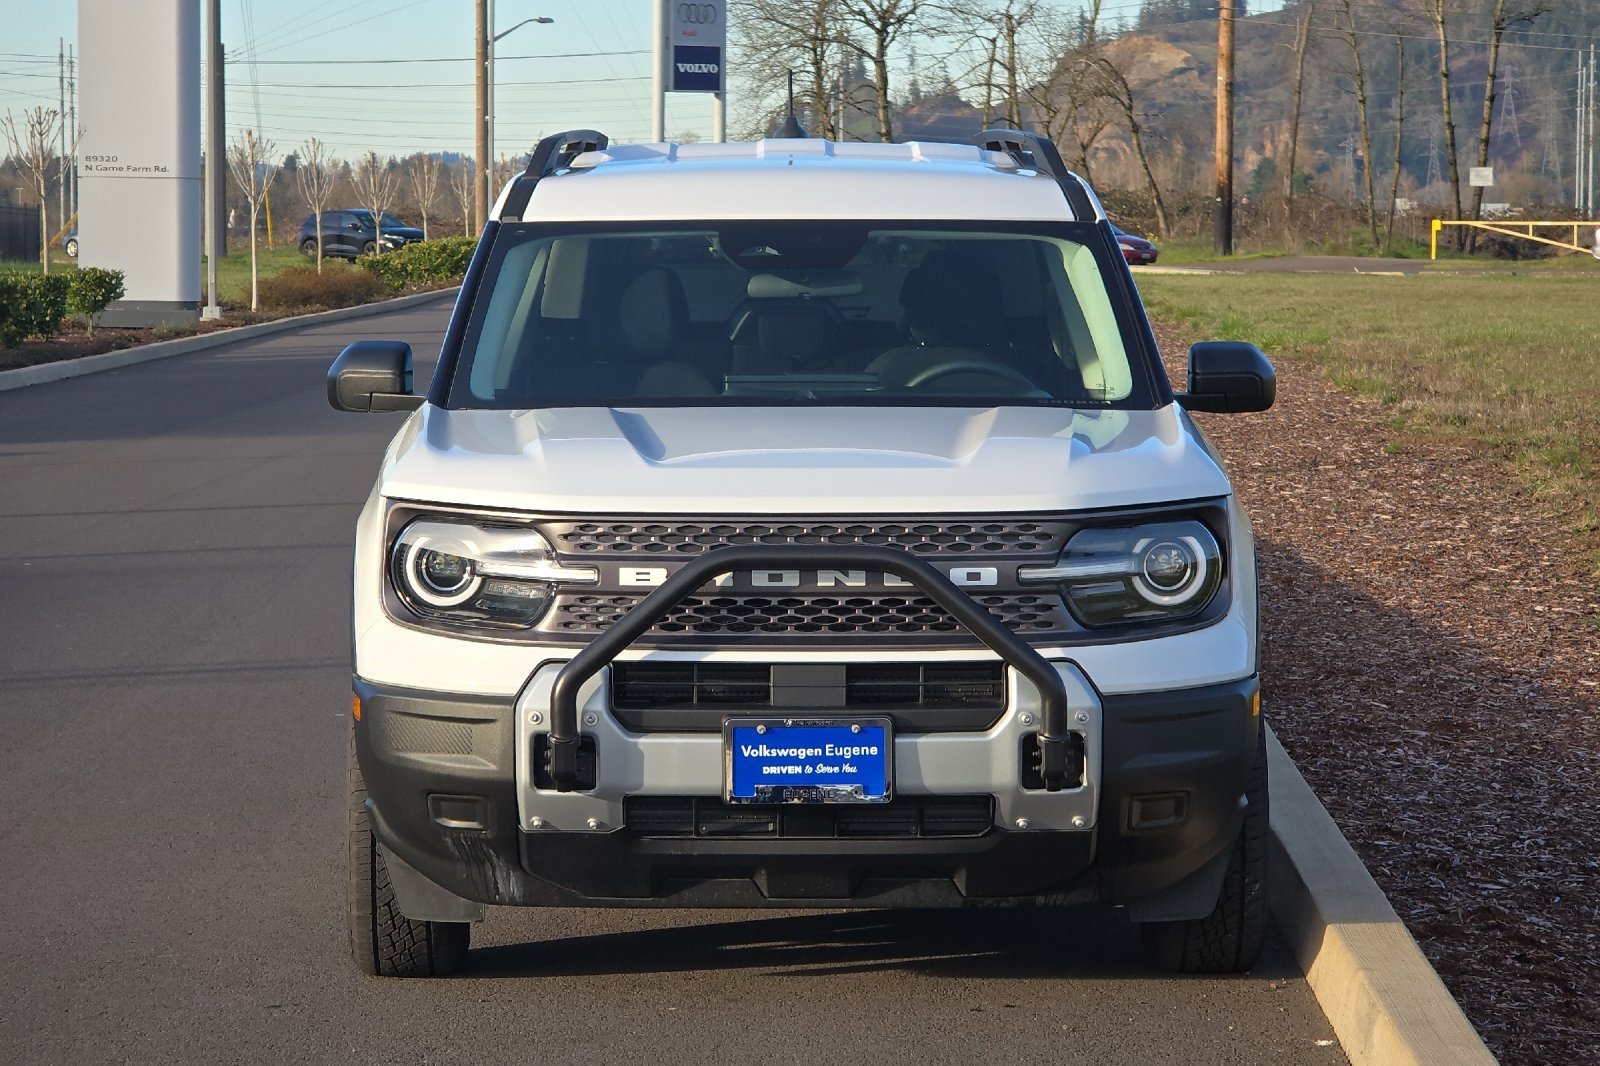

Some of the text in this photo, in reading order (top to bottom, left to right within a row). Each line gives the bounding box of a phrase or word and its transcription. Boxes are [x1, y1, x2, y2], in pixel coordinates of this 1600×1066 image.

[676, 63, 719, 74] VOLVO
[84, 155, 118, 163] 89320
[85, 164, 93, 172] N
[95, 164, 124, 172] Game
[154, 165, 170, 173] Rd.
[741, 743, 878, 760] Volkswagen Eugene
[762, 763, 858, 775] DRIVEN to Serve You
